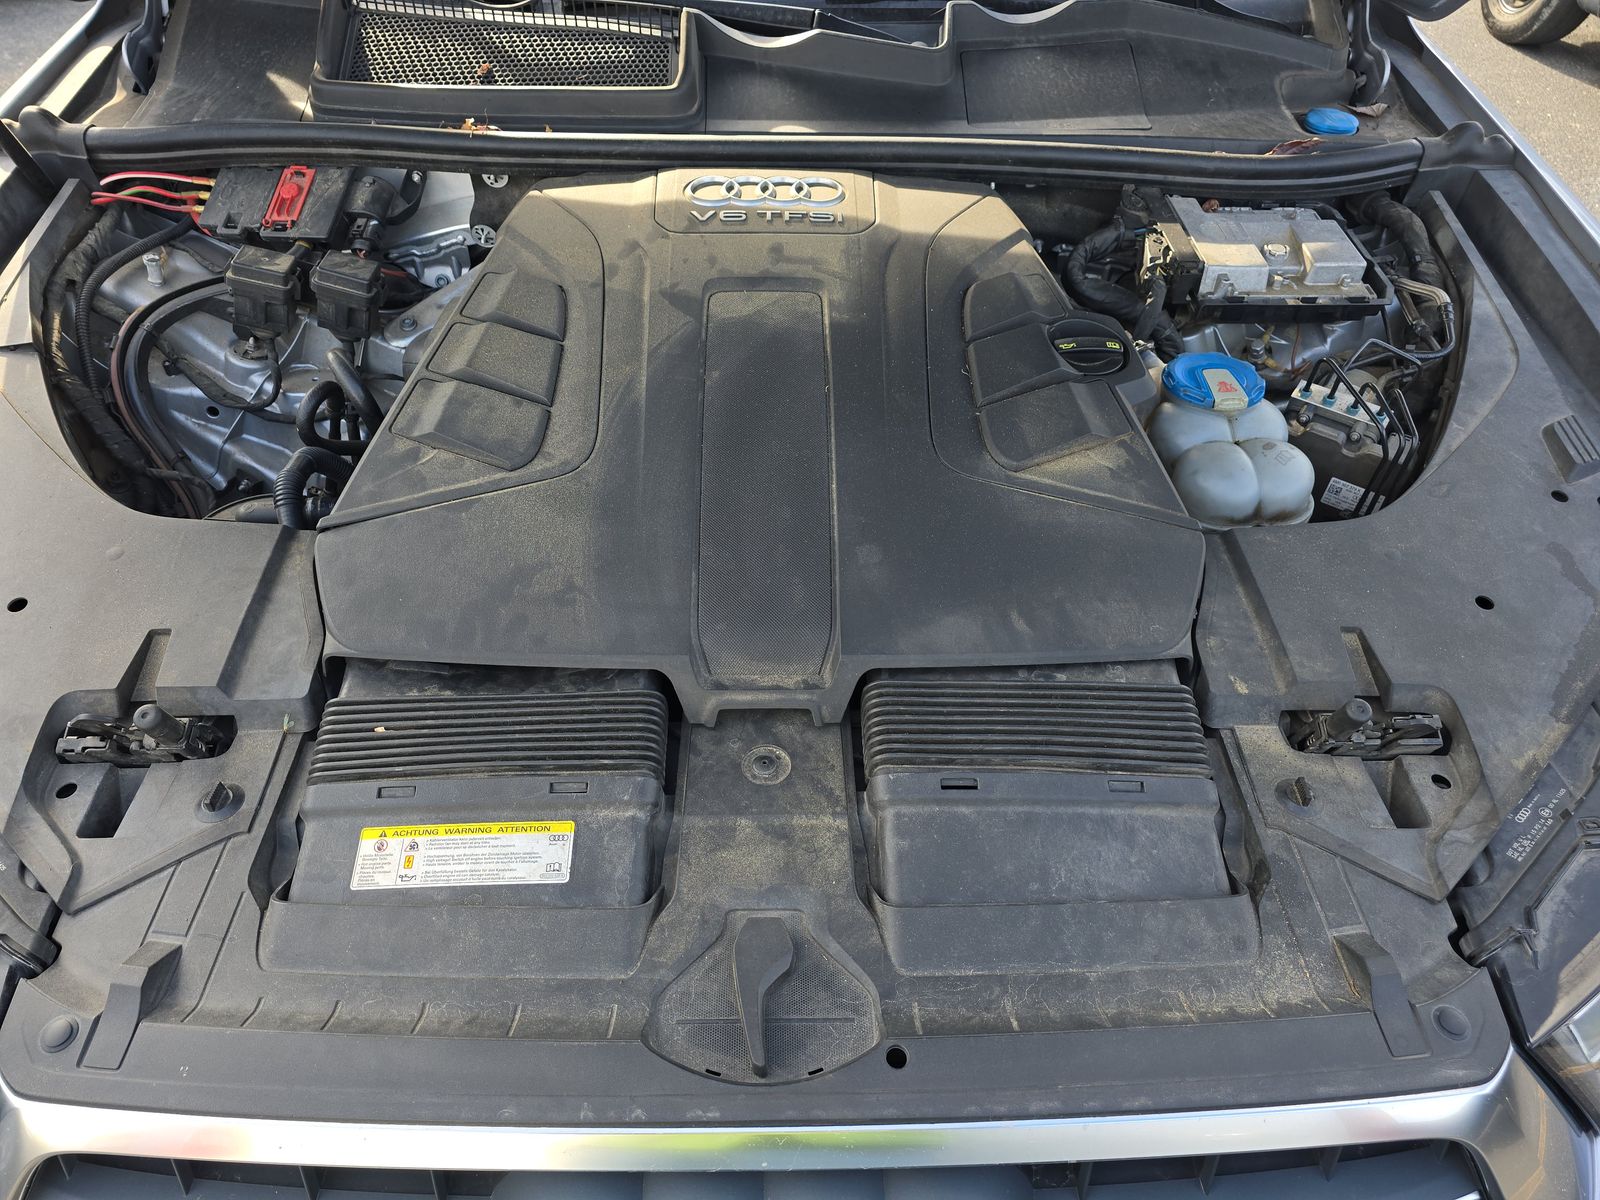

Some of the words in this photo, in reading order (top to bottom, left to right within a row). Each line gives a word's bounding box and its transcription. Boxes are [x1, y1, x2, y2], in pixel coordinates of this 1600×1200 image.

[690, 210, 747, 222] V6
[757, 210, 845, 224] TFSI
[392, 828, 439, 837] ACHTUNG
[444, 826, 492, 835] WARNING
